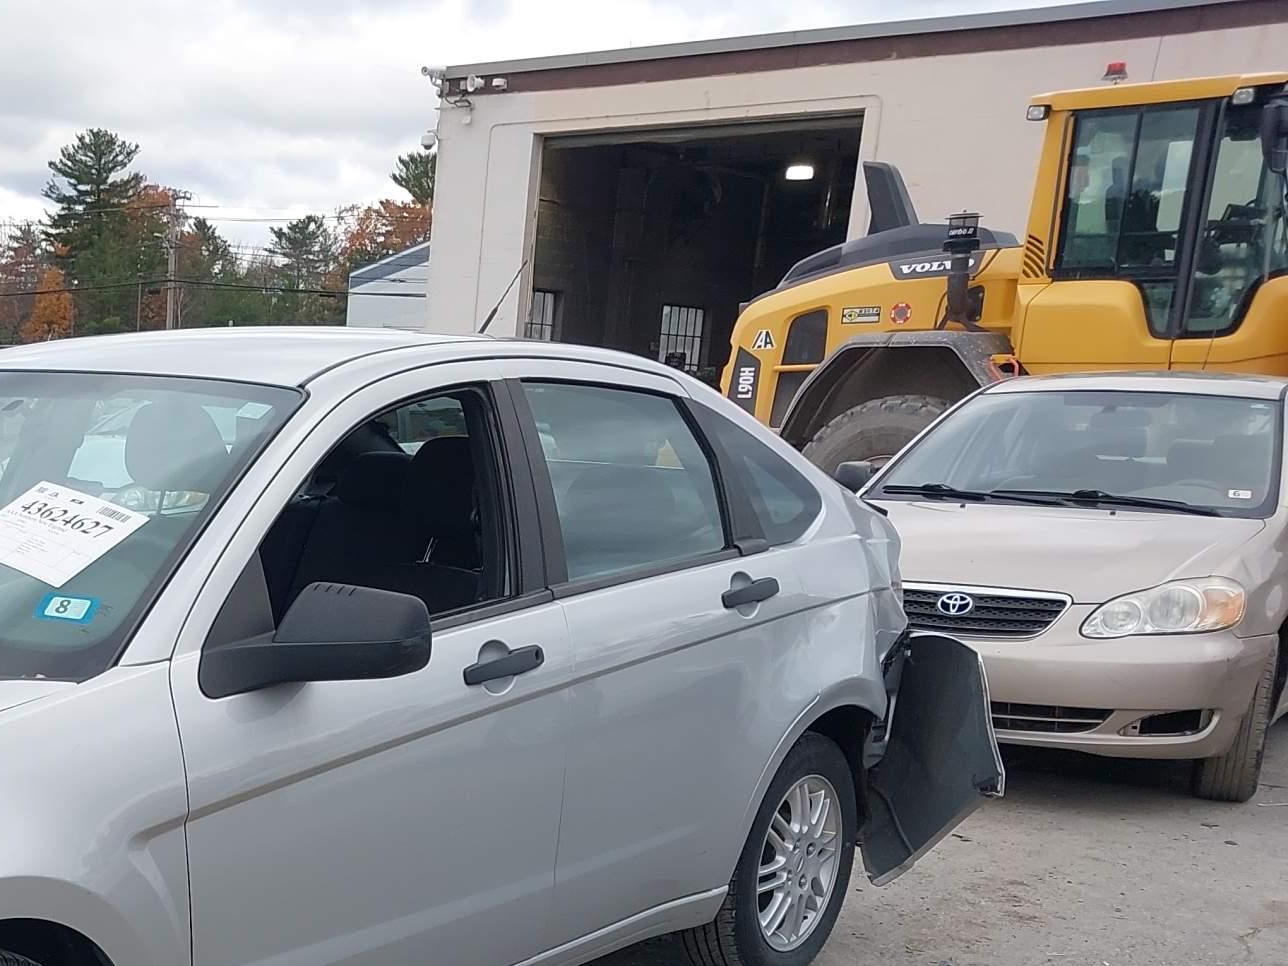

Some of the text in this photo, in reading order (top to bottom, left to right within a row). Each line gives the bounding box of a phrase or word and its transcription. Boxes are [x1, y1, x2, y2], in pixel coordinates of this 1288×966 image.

[737, 367, 755, 399] L90H
[21, 500, 114, 538] 43624627
[55, 599, 72, 614] 8
